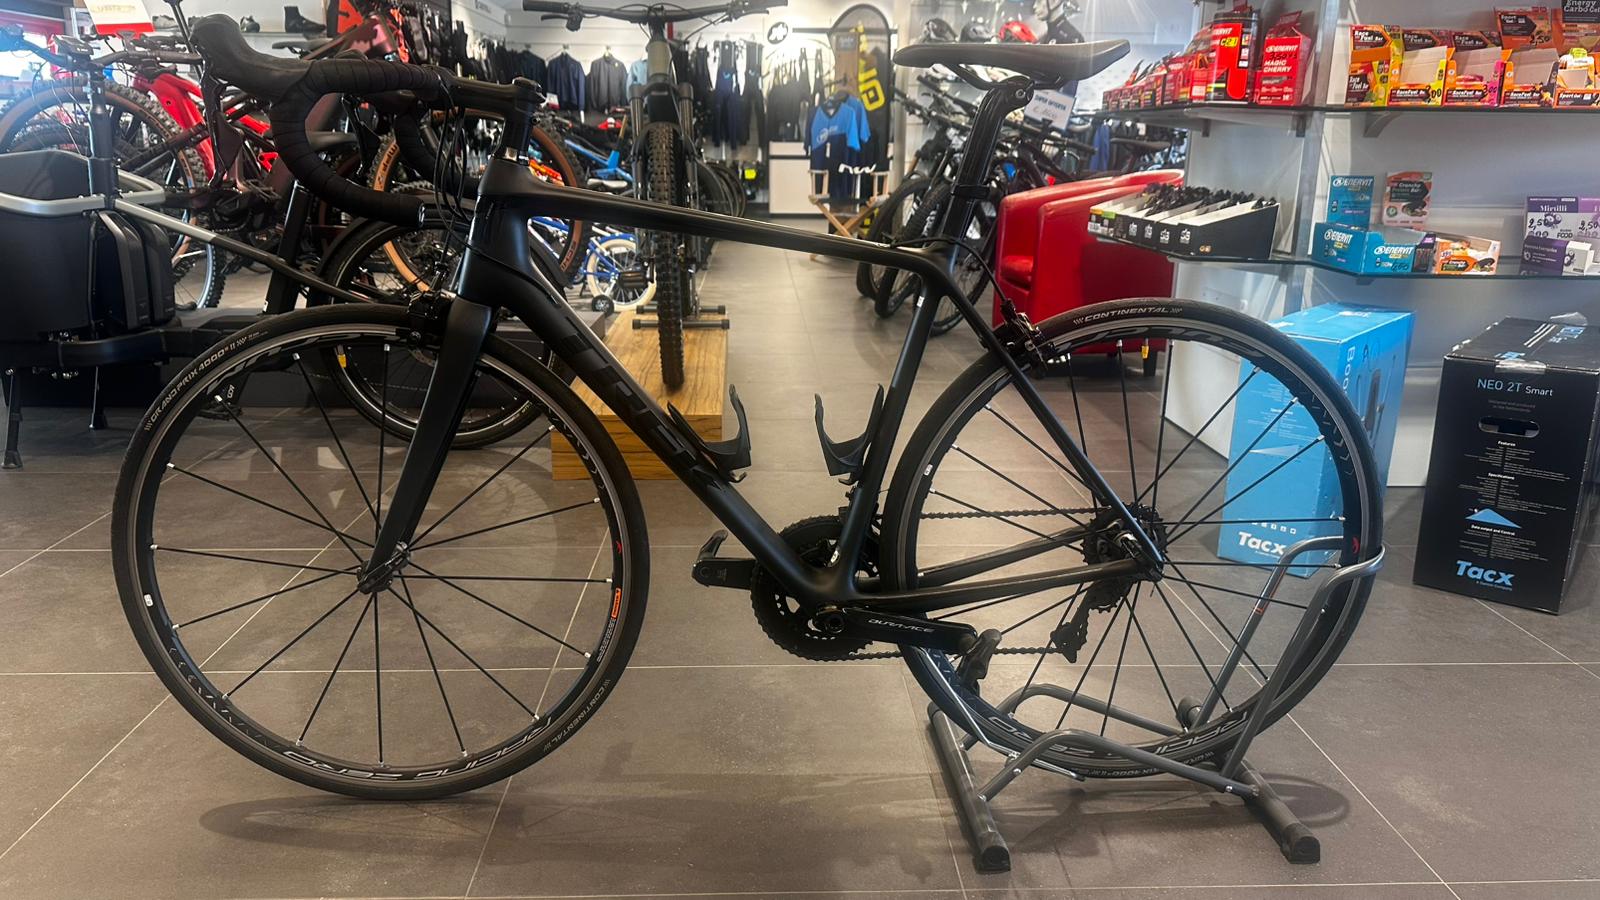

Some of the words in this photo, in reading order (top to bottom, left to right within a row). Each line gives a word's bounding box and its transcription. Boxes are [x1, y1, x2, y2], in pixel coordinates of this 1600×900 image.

[1344, 178, 1373, 187] ENERVIT
[1384, 246, 1414, 254] ENERVIT
[1084, 307, 1169, 323] CONTINENTAL
[150, 388, 179, 423] GRAND
[176, 369, 199, 391] PRIX
[1477, 378, 1504, 391] NEO
[1507, 381, 1523, 393] 2T
[1525, 385, 1553, 397] Smart
[1238, 531, 1287, 555] Tacx
[1456, 560, 1515, 586] Tacx
[552, 686, 606, 745] CONTINENTAL
